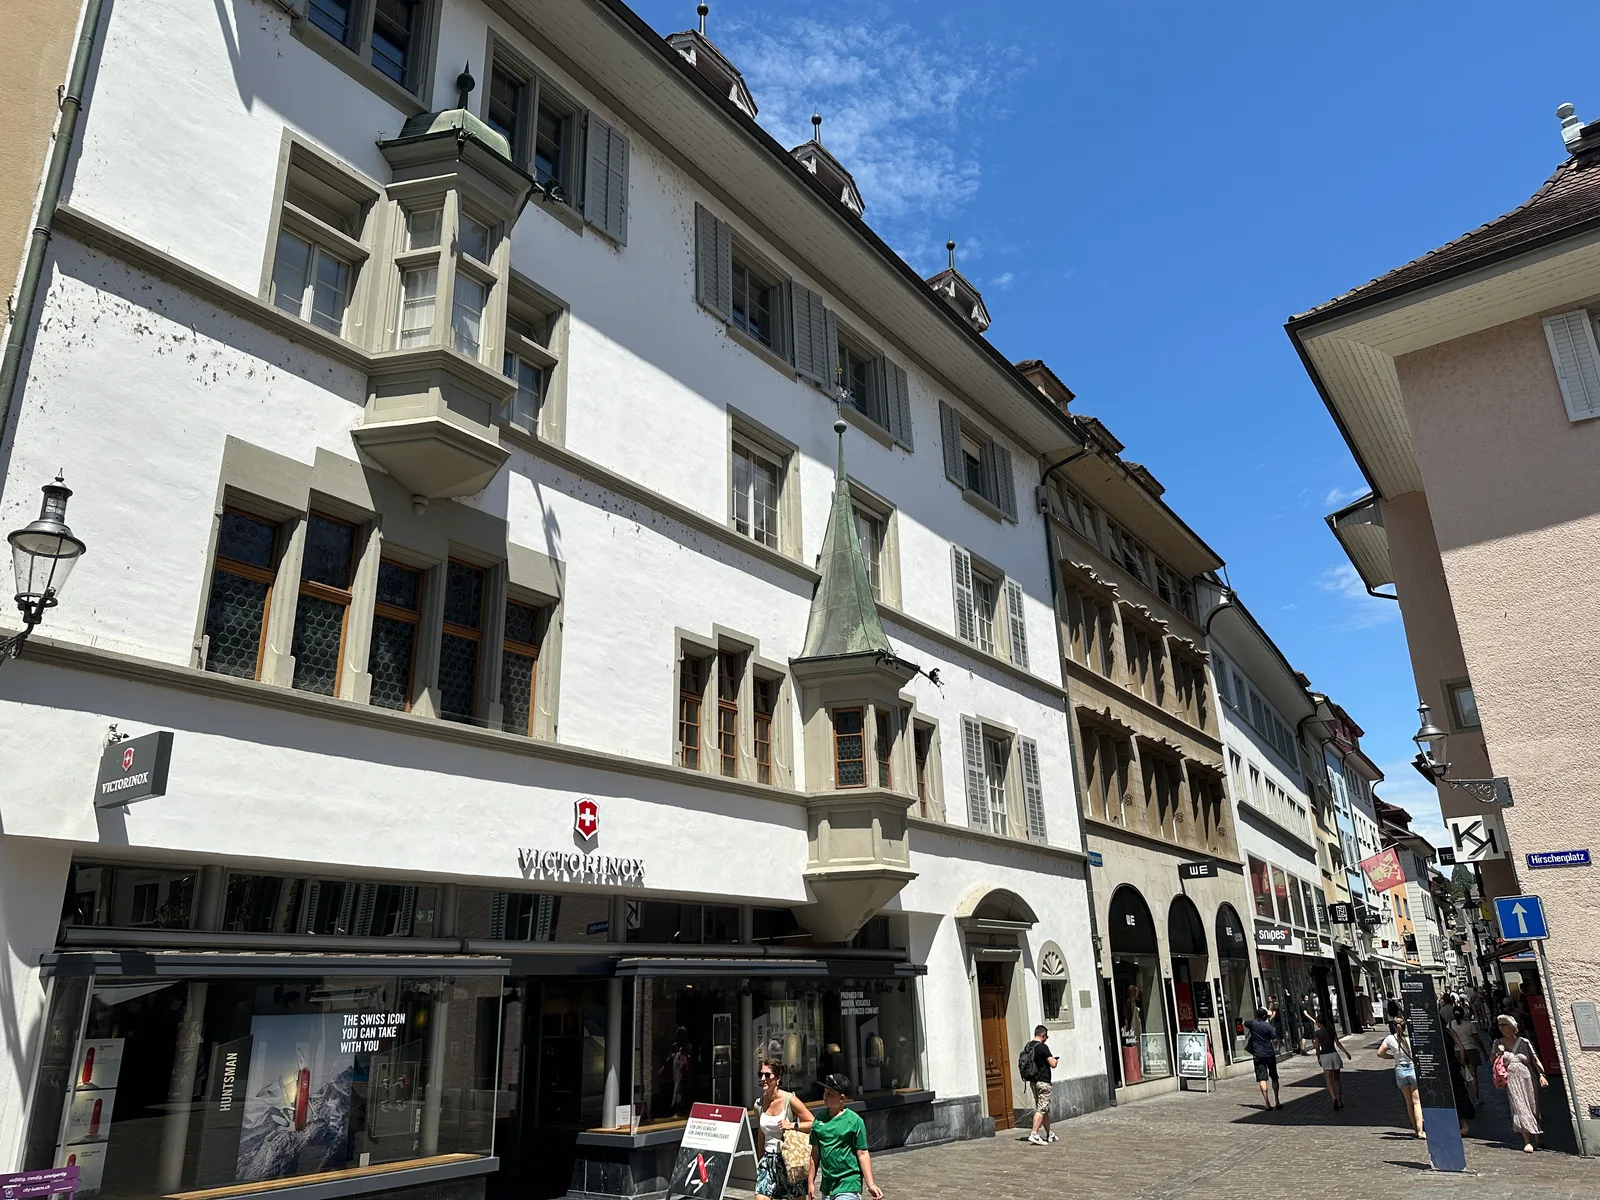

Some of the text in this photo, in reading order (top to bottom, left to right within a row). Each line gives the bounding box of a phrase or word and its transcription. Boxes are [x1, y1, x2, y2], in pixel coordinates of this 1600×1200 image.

[102, 772, 149, 794] VICTORINOX
[517, 848, 646, 877] VICTORINOX
[1531, 852, 1585, 864] Hirschenplatz
[1189, 865, 1208, 876] WE
[1259, 929, 1286, 942] snipes
[343, 1013, 406, 1026] THE SWISS ICON
[342, 1026, 397, 1040] YOU CAN TAKE
[340, 1040, 380, 1053] WITH YOU
[219, 1052, 238, 1112] HUNTSMAN
